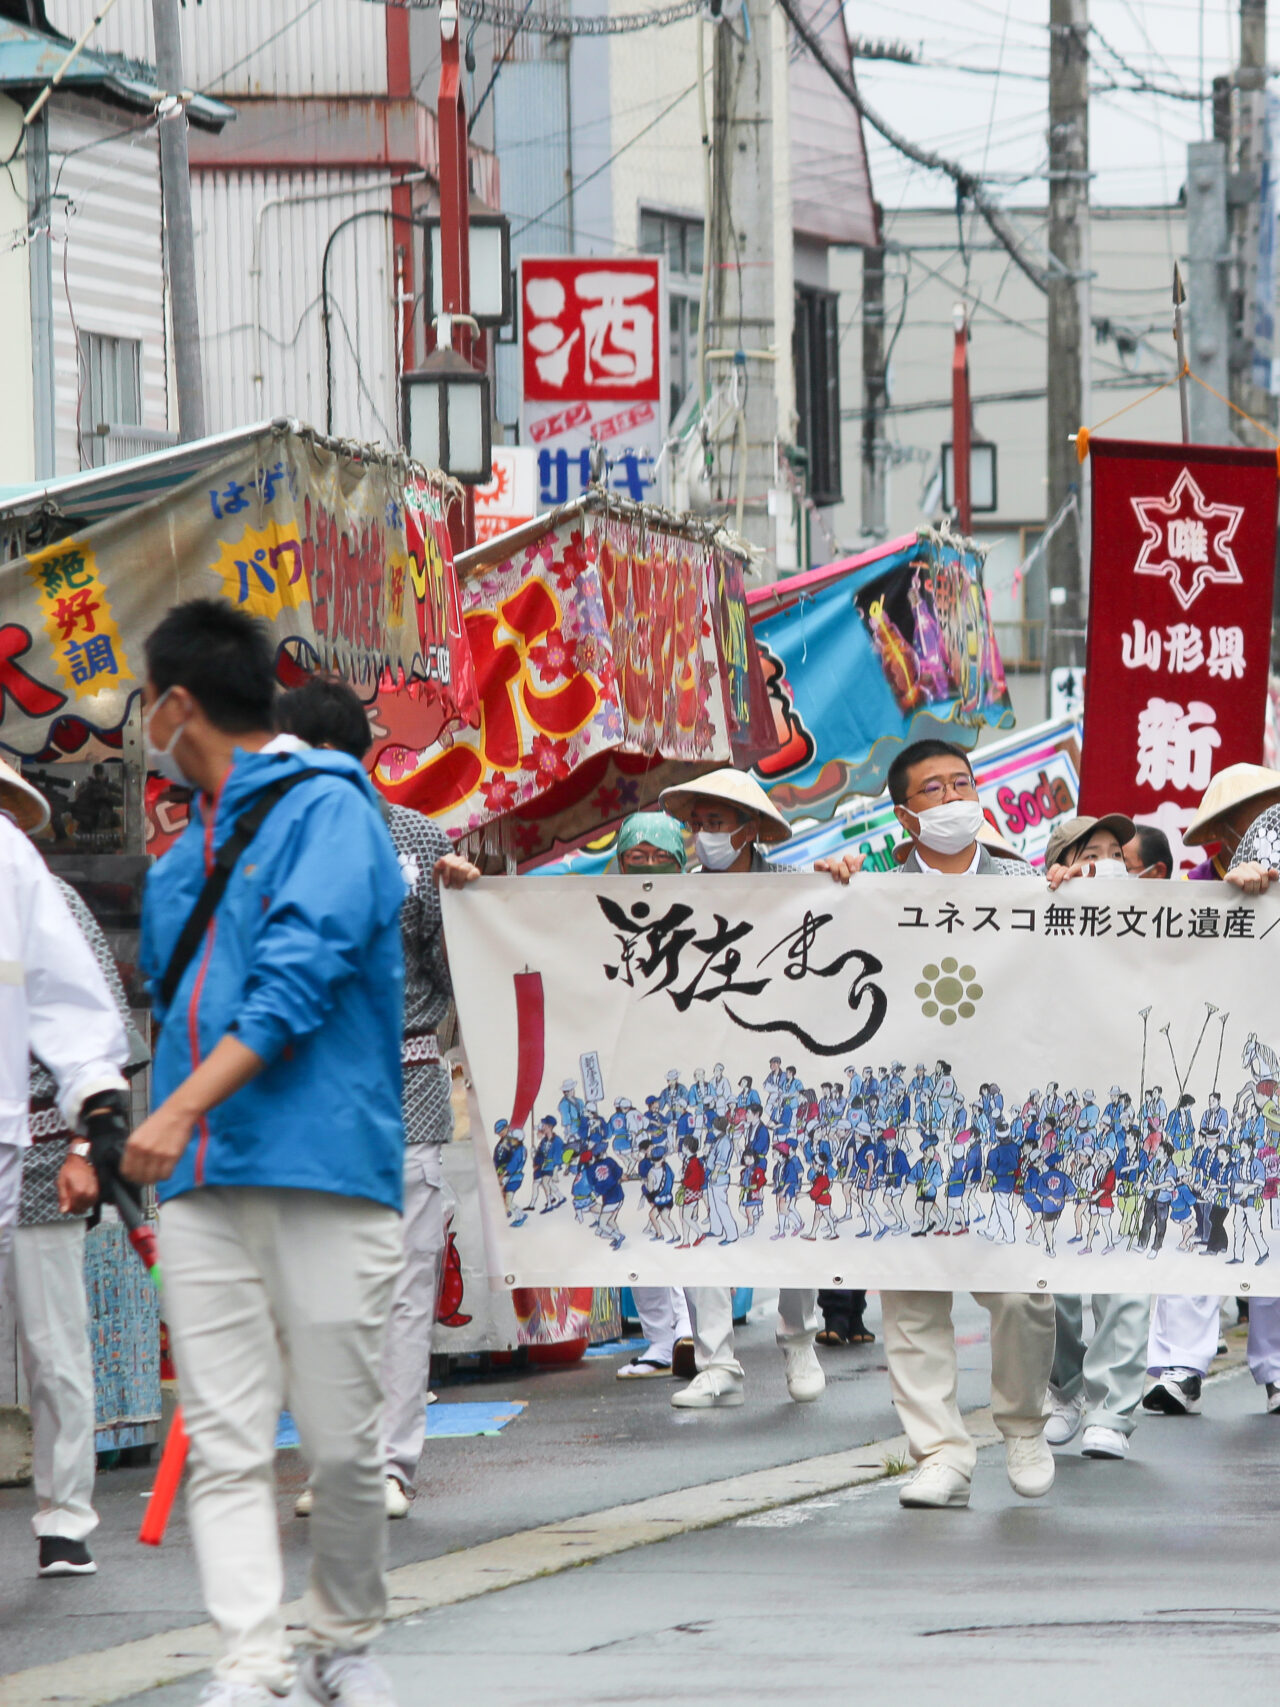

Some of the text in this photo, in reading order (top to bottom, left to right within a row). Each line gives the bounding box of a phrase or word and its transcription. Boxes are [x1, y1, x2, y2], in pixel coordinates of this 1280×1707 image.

[525, 270, 655, 388] 酒
[39, 547, 119, 686] 絶好調
[1121, 619, 1246, 680] 山形県
[997, 770, 1075, 834] Soda
